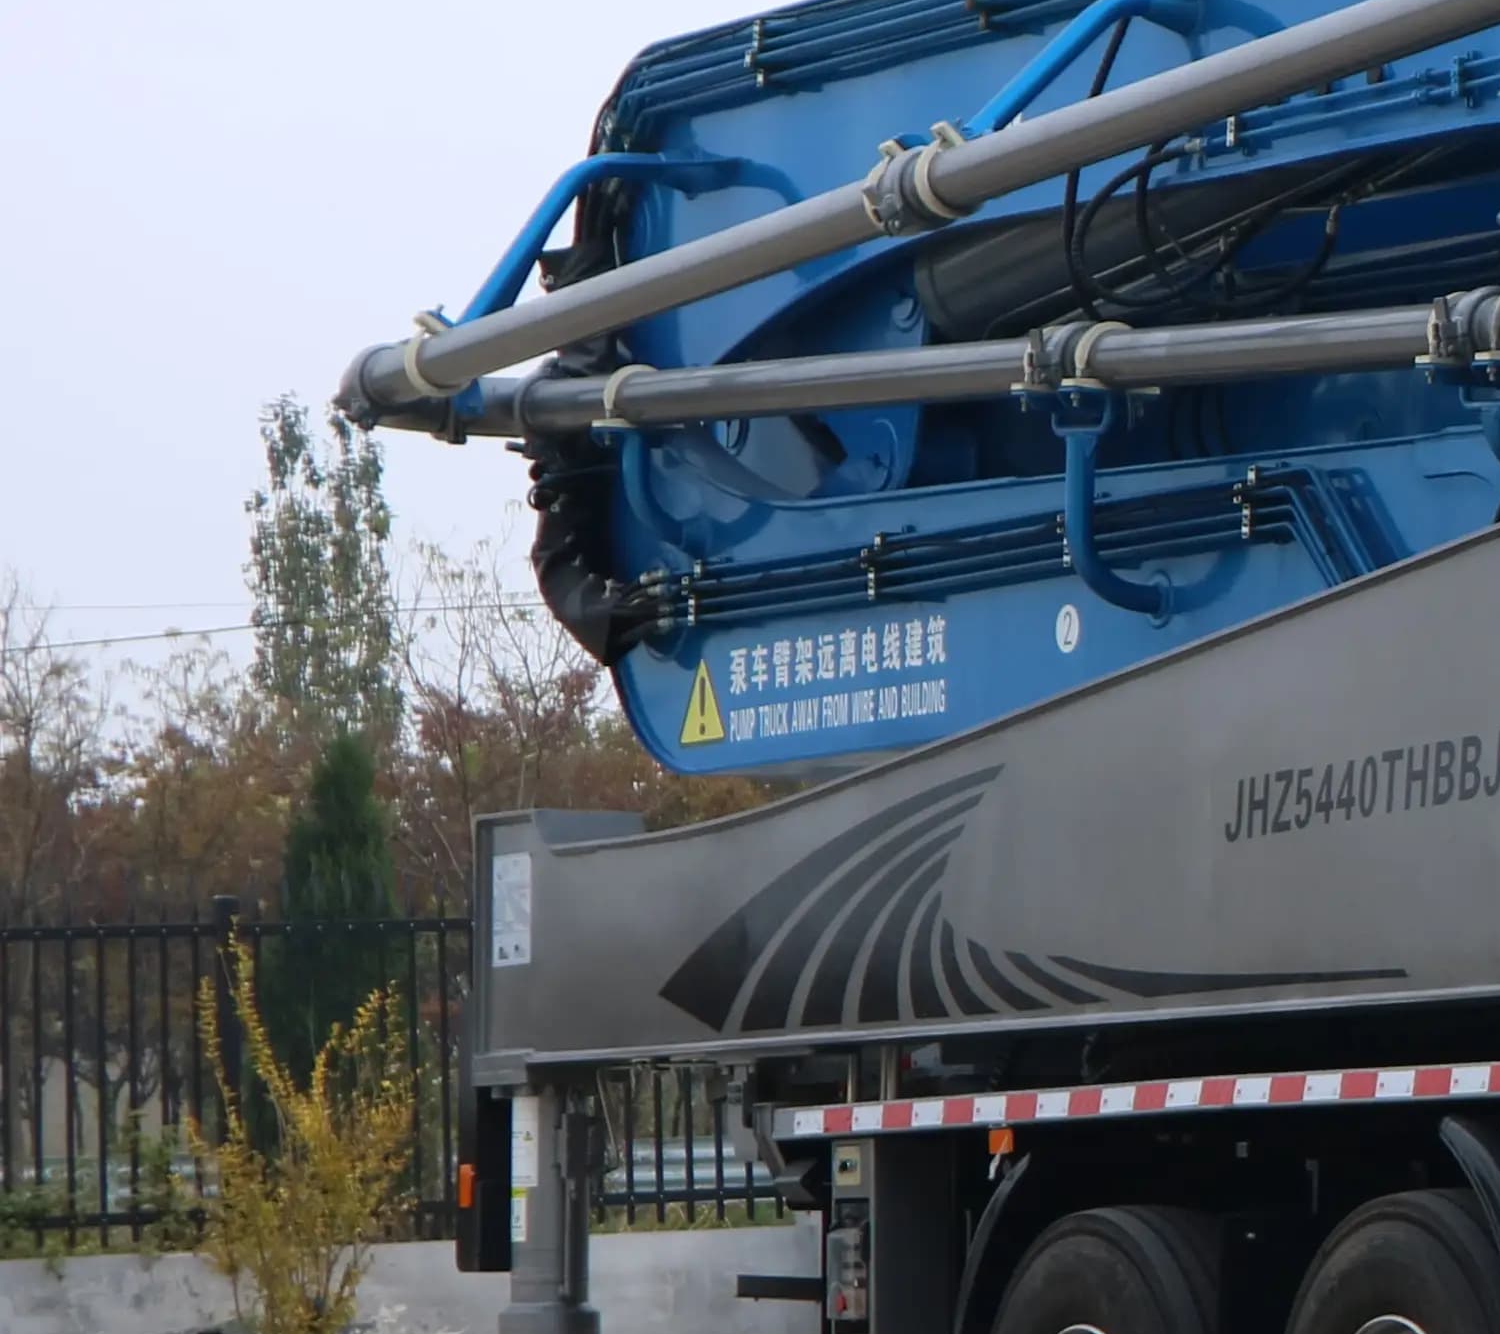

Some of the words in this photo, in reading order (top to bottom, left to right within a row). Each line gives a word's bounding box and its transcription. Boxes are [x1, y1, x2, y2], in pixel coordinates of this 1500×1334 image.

[729, 614, 946, 695] 泵车臂架远离电线建筑
[729, 708, 756, 743] PUMP
[758, 703, 789, 738] TRUCK
[791, 698, 820, 732] AWAY
[822, 693, 849, 729] FROM
[851, 688, 876, 724] WIRE
[877, 684, 899, 721] AND
[901, 678, 946, 718] BUILDING
